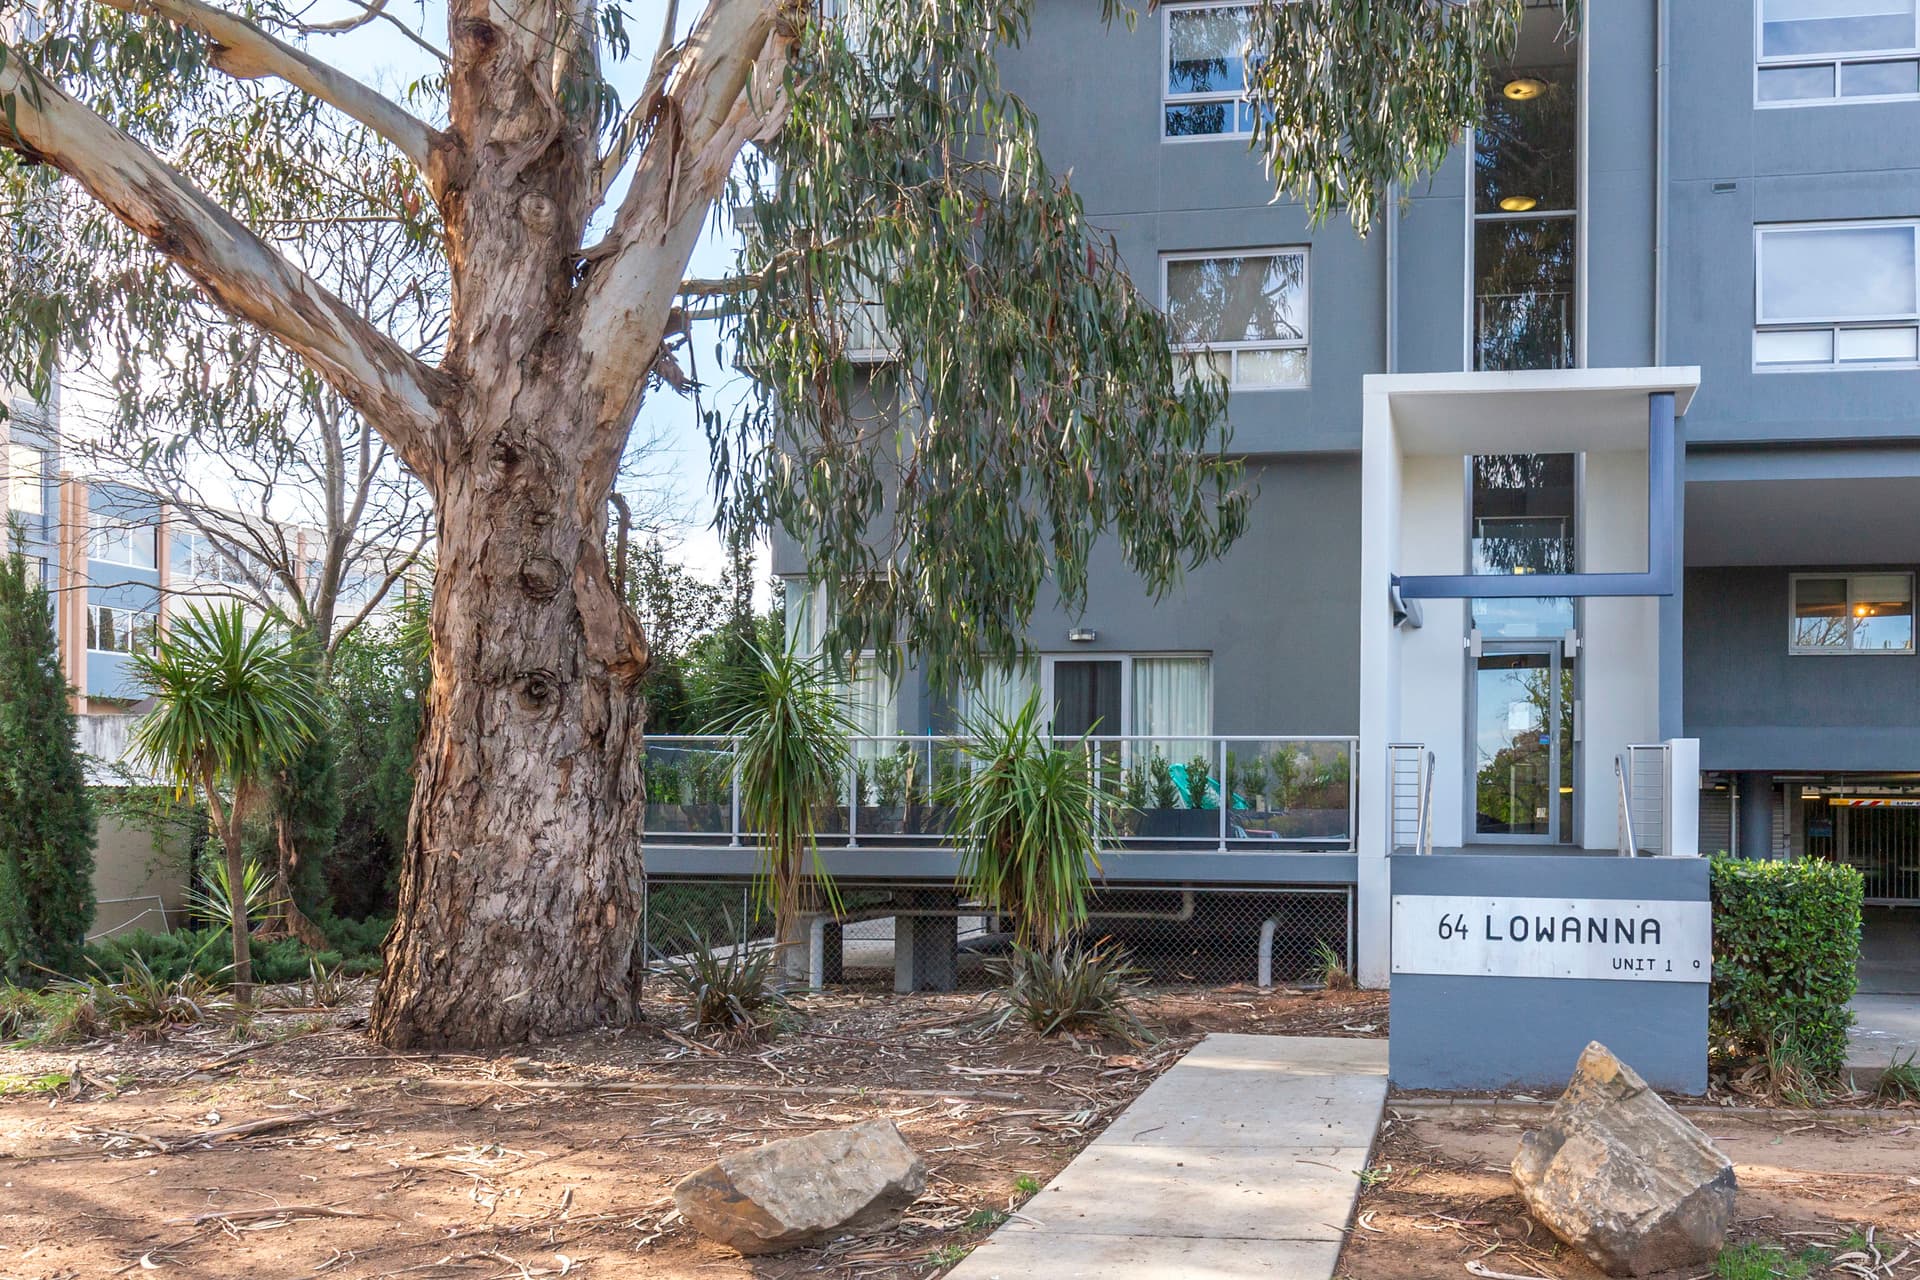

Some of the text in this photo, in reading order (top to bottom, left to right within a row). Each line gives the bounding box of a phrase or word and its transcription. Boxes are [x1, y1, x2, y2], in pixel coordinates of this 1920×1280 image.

[1438, 913, 1661, 945] 64 LOWANNA
[1612, 957, 1656, 971] UNIT
[1665, 959, 1673, 972] 1
